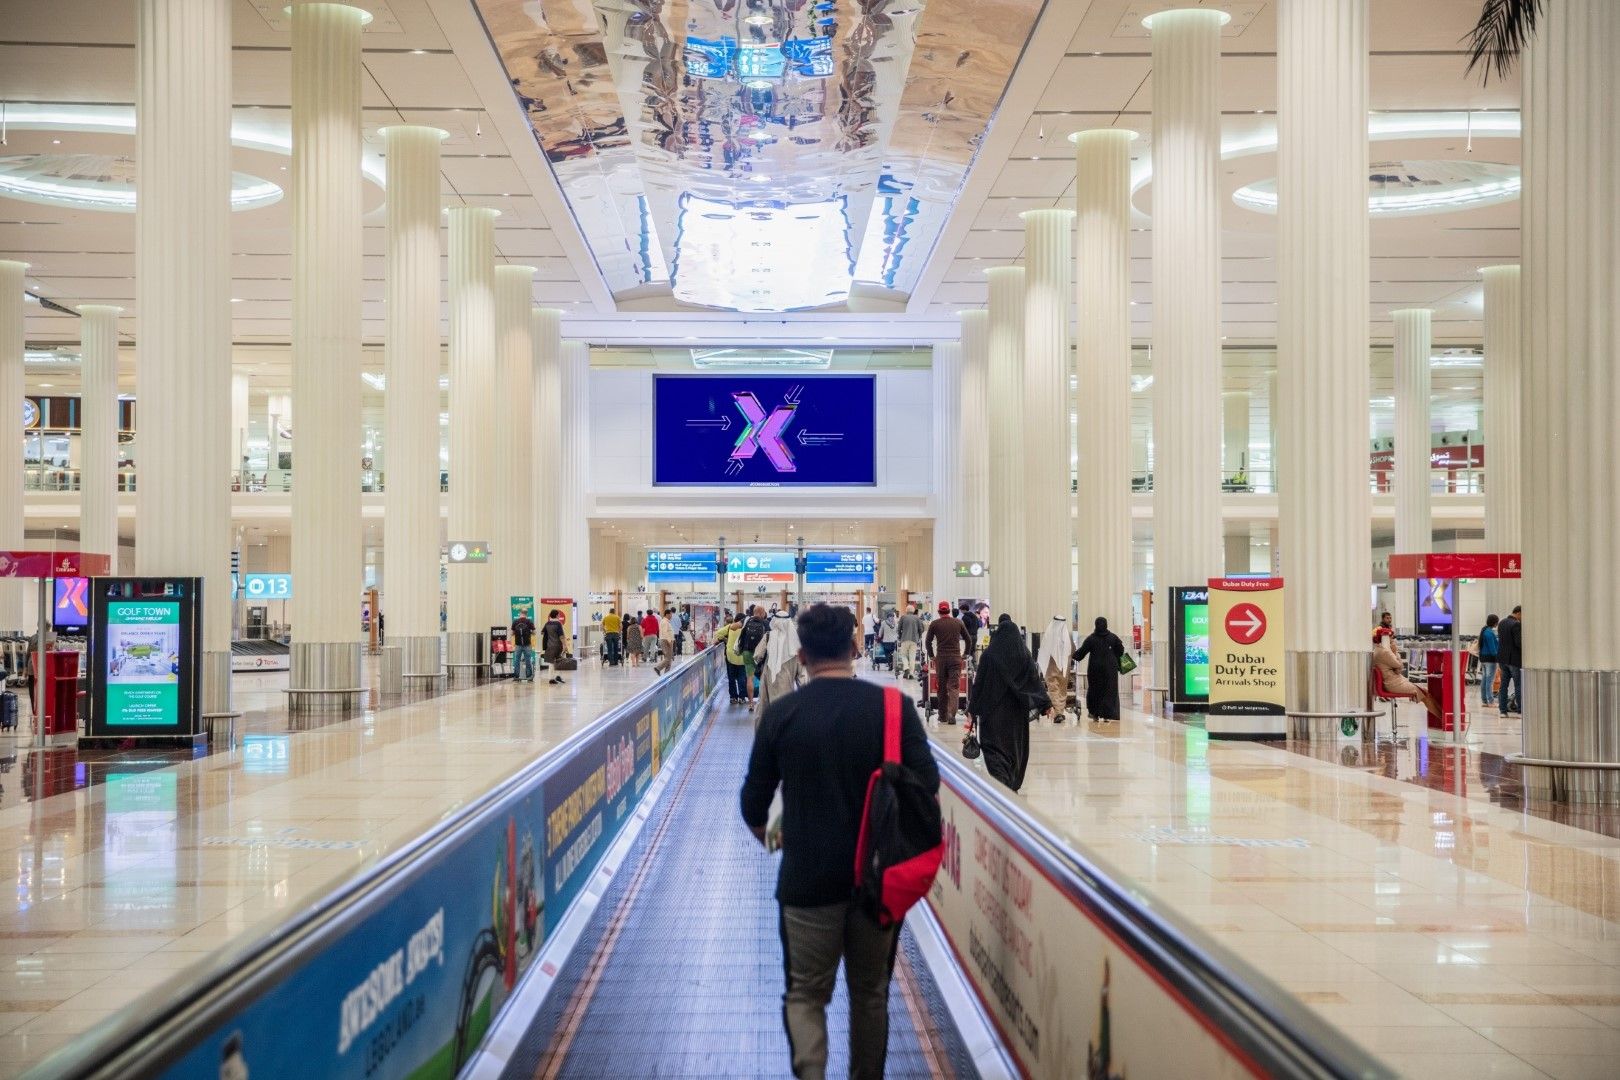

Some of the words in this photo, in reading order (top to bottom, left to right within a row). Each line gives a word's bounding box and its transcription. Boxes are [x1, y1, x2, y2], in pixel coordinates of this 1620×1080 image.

[267, 578, 288, 595] 13
[117, 607, 141, 616] GOLF
[142, 607, 171, 616] TOWN
[1226, 653, 1265, 664] Dubai
[1215, 665, 1246, 679] Duty
[1249, 665, 1278, 676] Free
[1215, 678, 1251, 686] Arrivals
[1253, 678, 1277, 688] Shop
